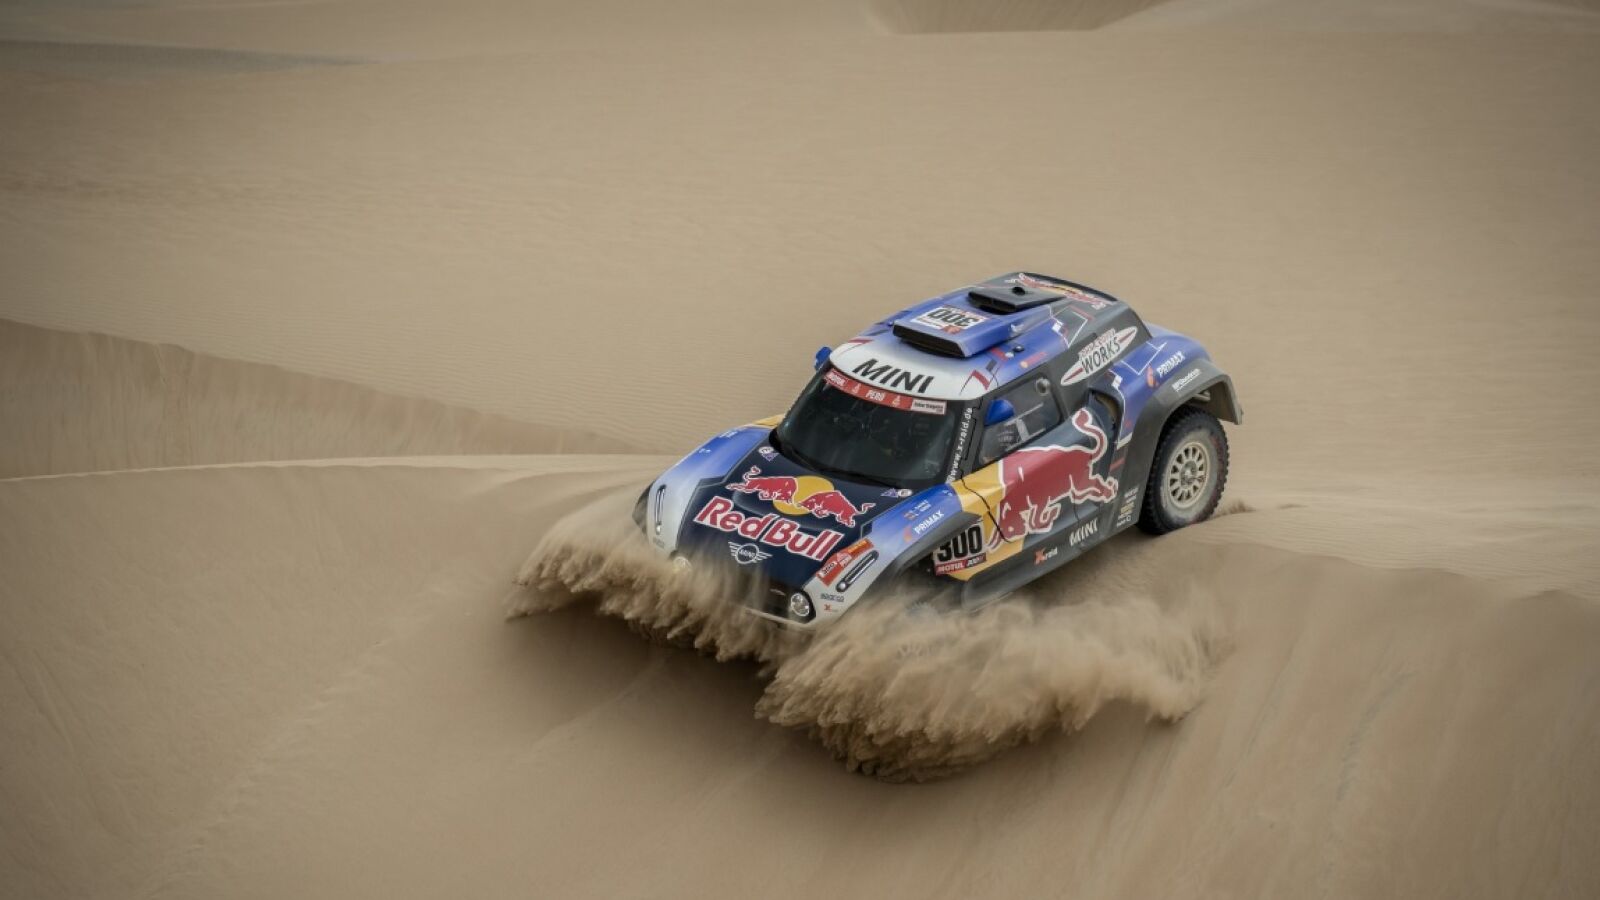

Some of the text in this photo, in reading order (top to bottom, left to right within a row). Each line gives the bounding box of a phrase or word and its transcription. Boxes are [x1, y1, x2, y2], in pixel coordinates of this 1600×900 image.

[926, 307, 979, 328] 300
[1081, 336, 1120, 374] WORKS
[1156, 351, 1186, 377] PRIMAX
[852, 358, 935, 393] MINI
[693, 496, 845, 562] Red Bull
[914, 510, 944, 535] PRIMAX
[1069, 518, 1098, 547] MINI
[937, 525, 983, 562] 300
[938, 562, 965, 574] MOTUL
